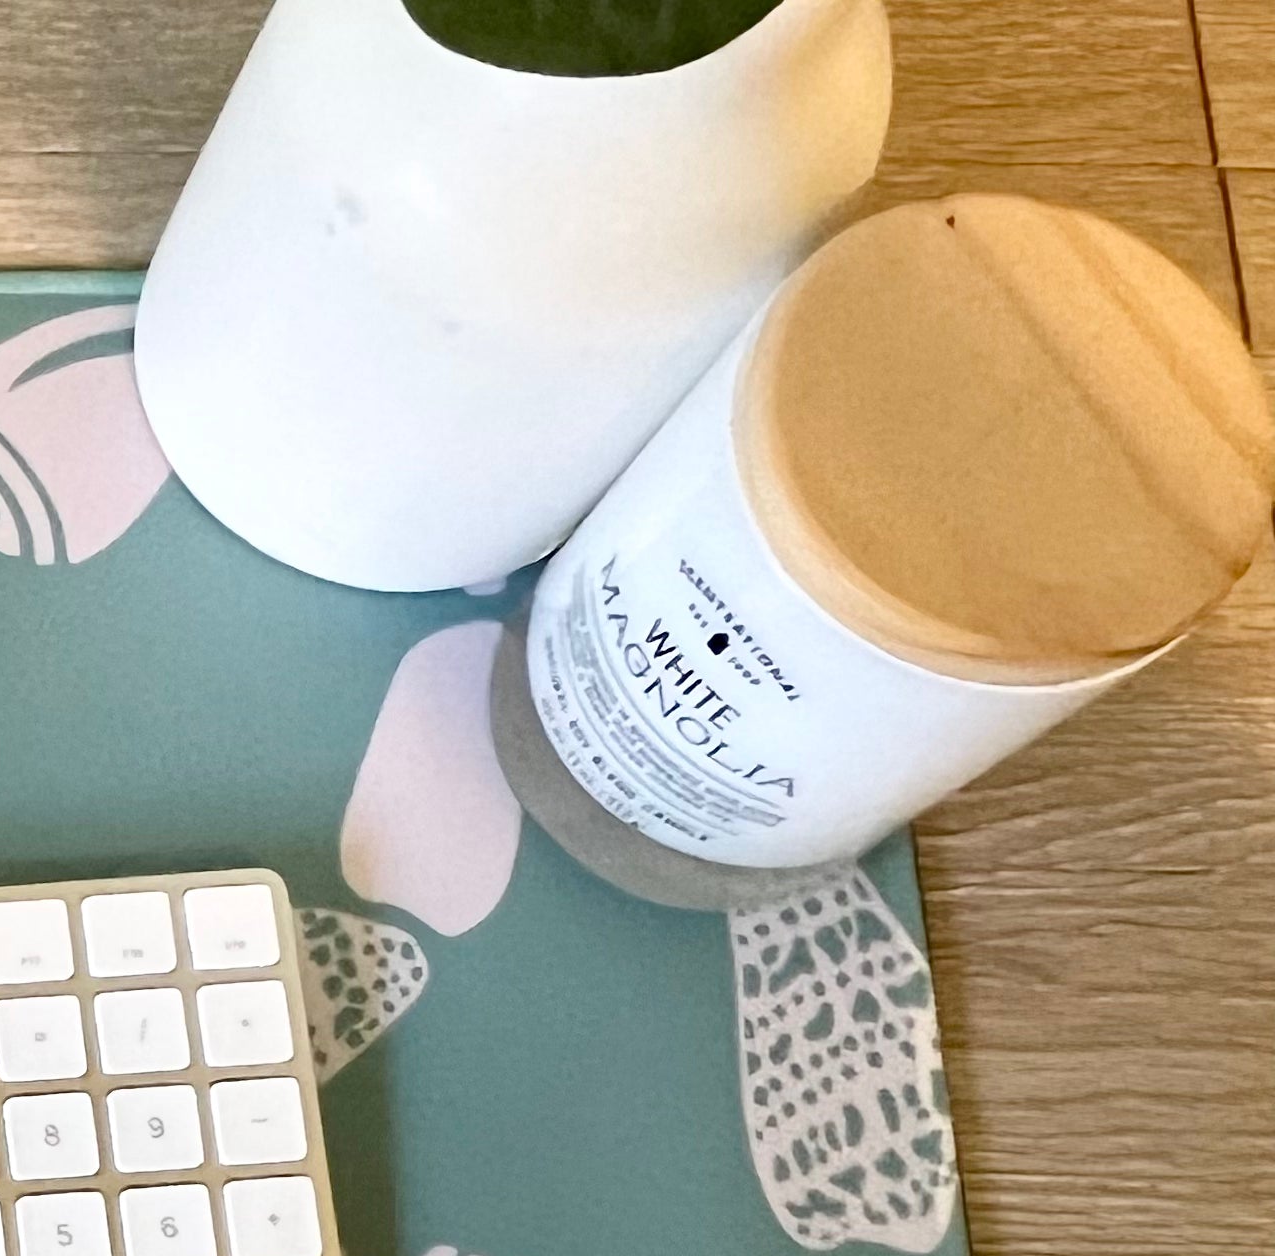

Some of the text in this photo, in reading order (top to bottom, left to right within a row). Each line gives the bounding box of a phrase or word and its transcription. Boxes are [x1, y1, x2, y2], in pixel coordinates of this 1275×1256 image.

[644, 617, 742, 730] WHITE
[43, 1123, 61, 1148] 8
[147, 1116, 165, 1139] 9
[56, 1223, 74, 1248] 5
[159, 1215, 180, 1239] 6
